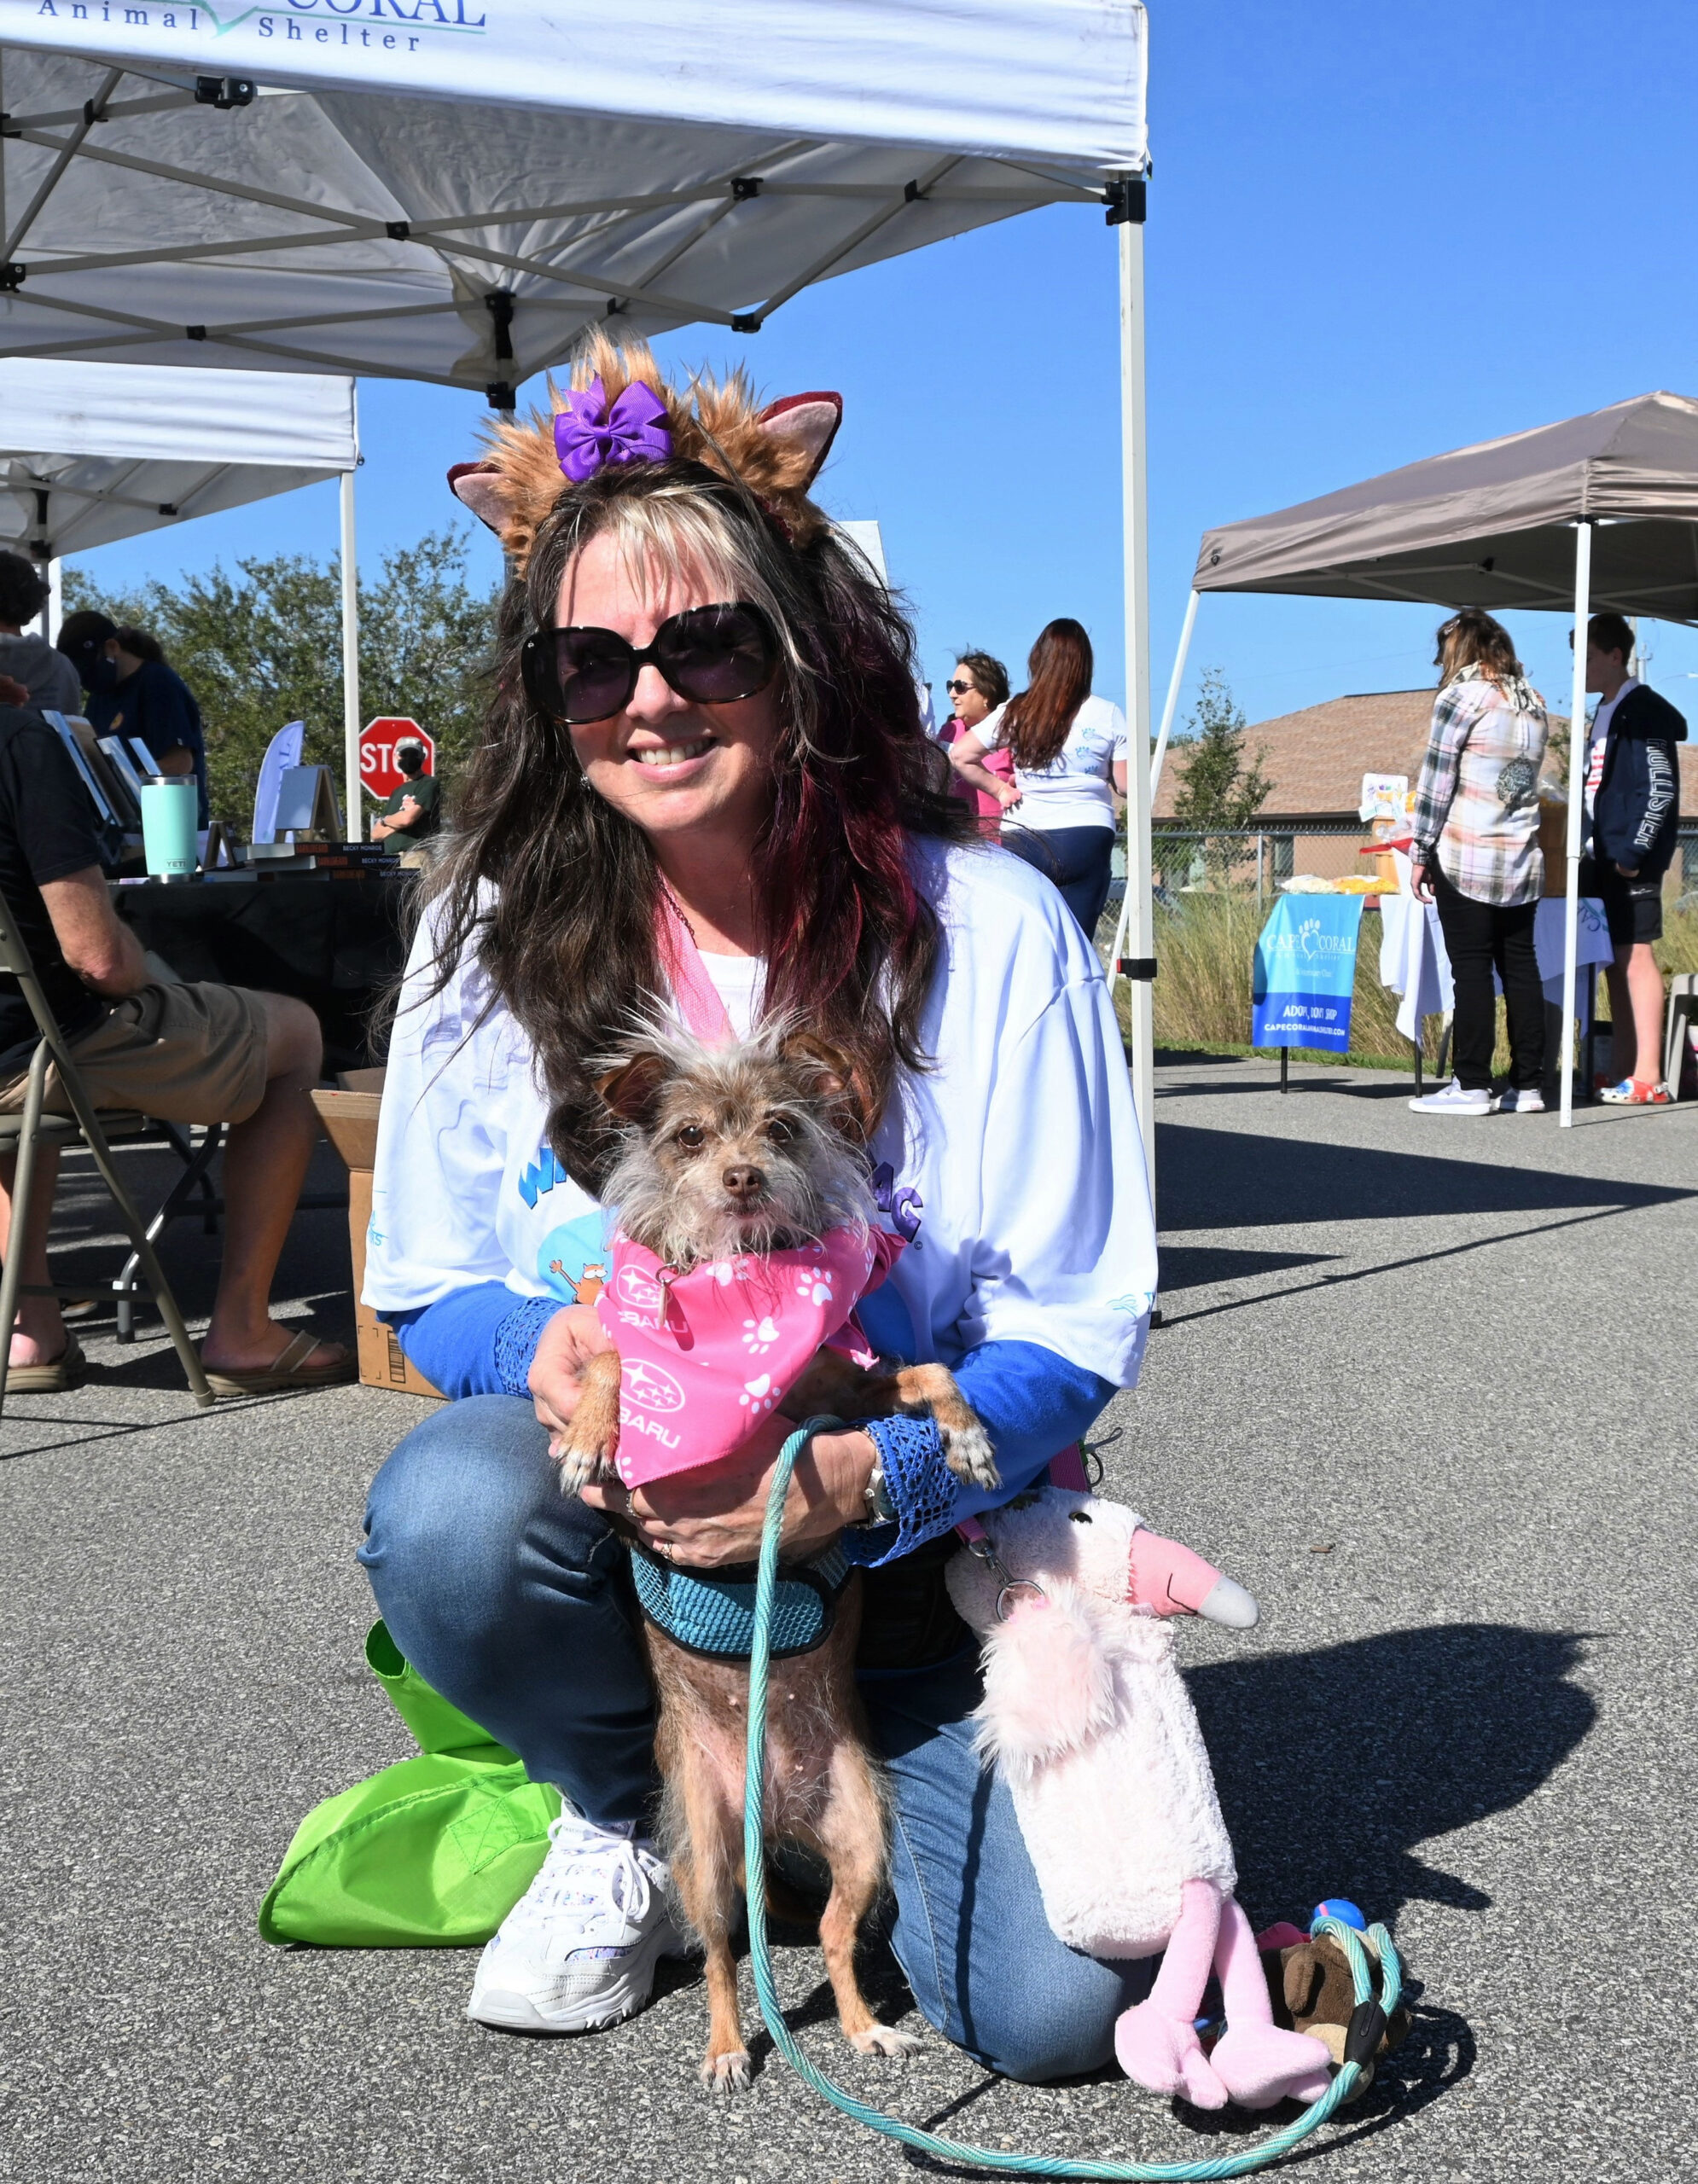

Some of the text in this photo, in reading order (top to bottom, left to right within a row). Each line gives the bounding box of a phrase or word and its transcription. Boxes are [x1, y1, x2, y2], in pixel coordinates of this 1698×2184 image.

[38, 0, 419, 51] Animal Shelter
[1633, 738, 1675, 850] HOLLISTER
[1266, 933, 1355, 952] CAPE CORAL
